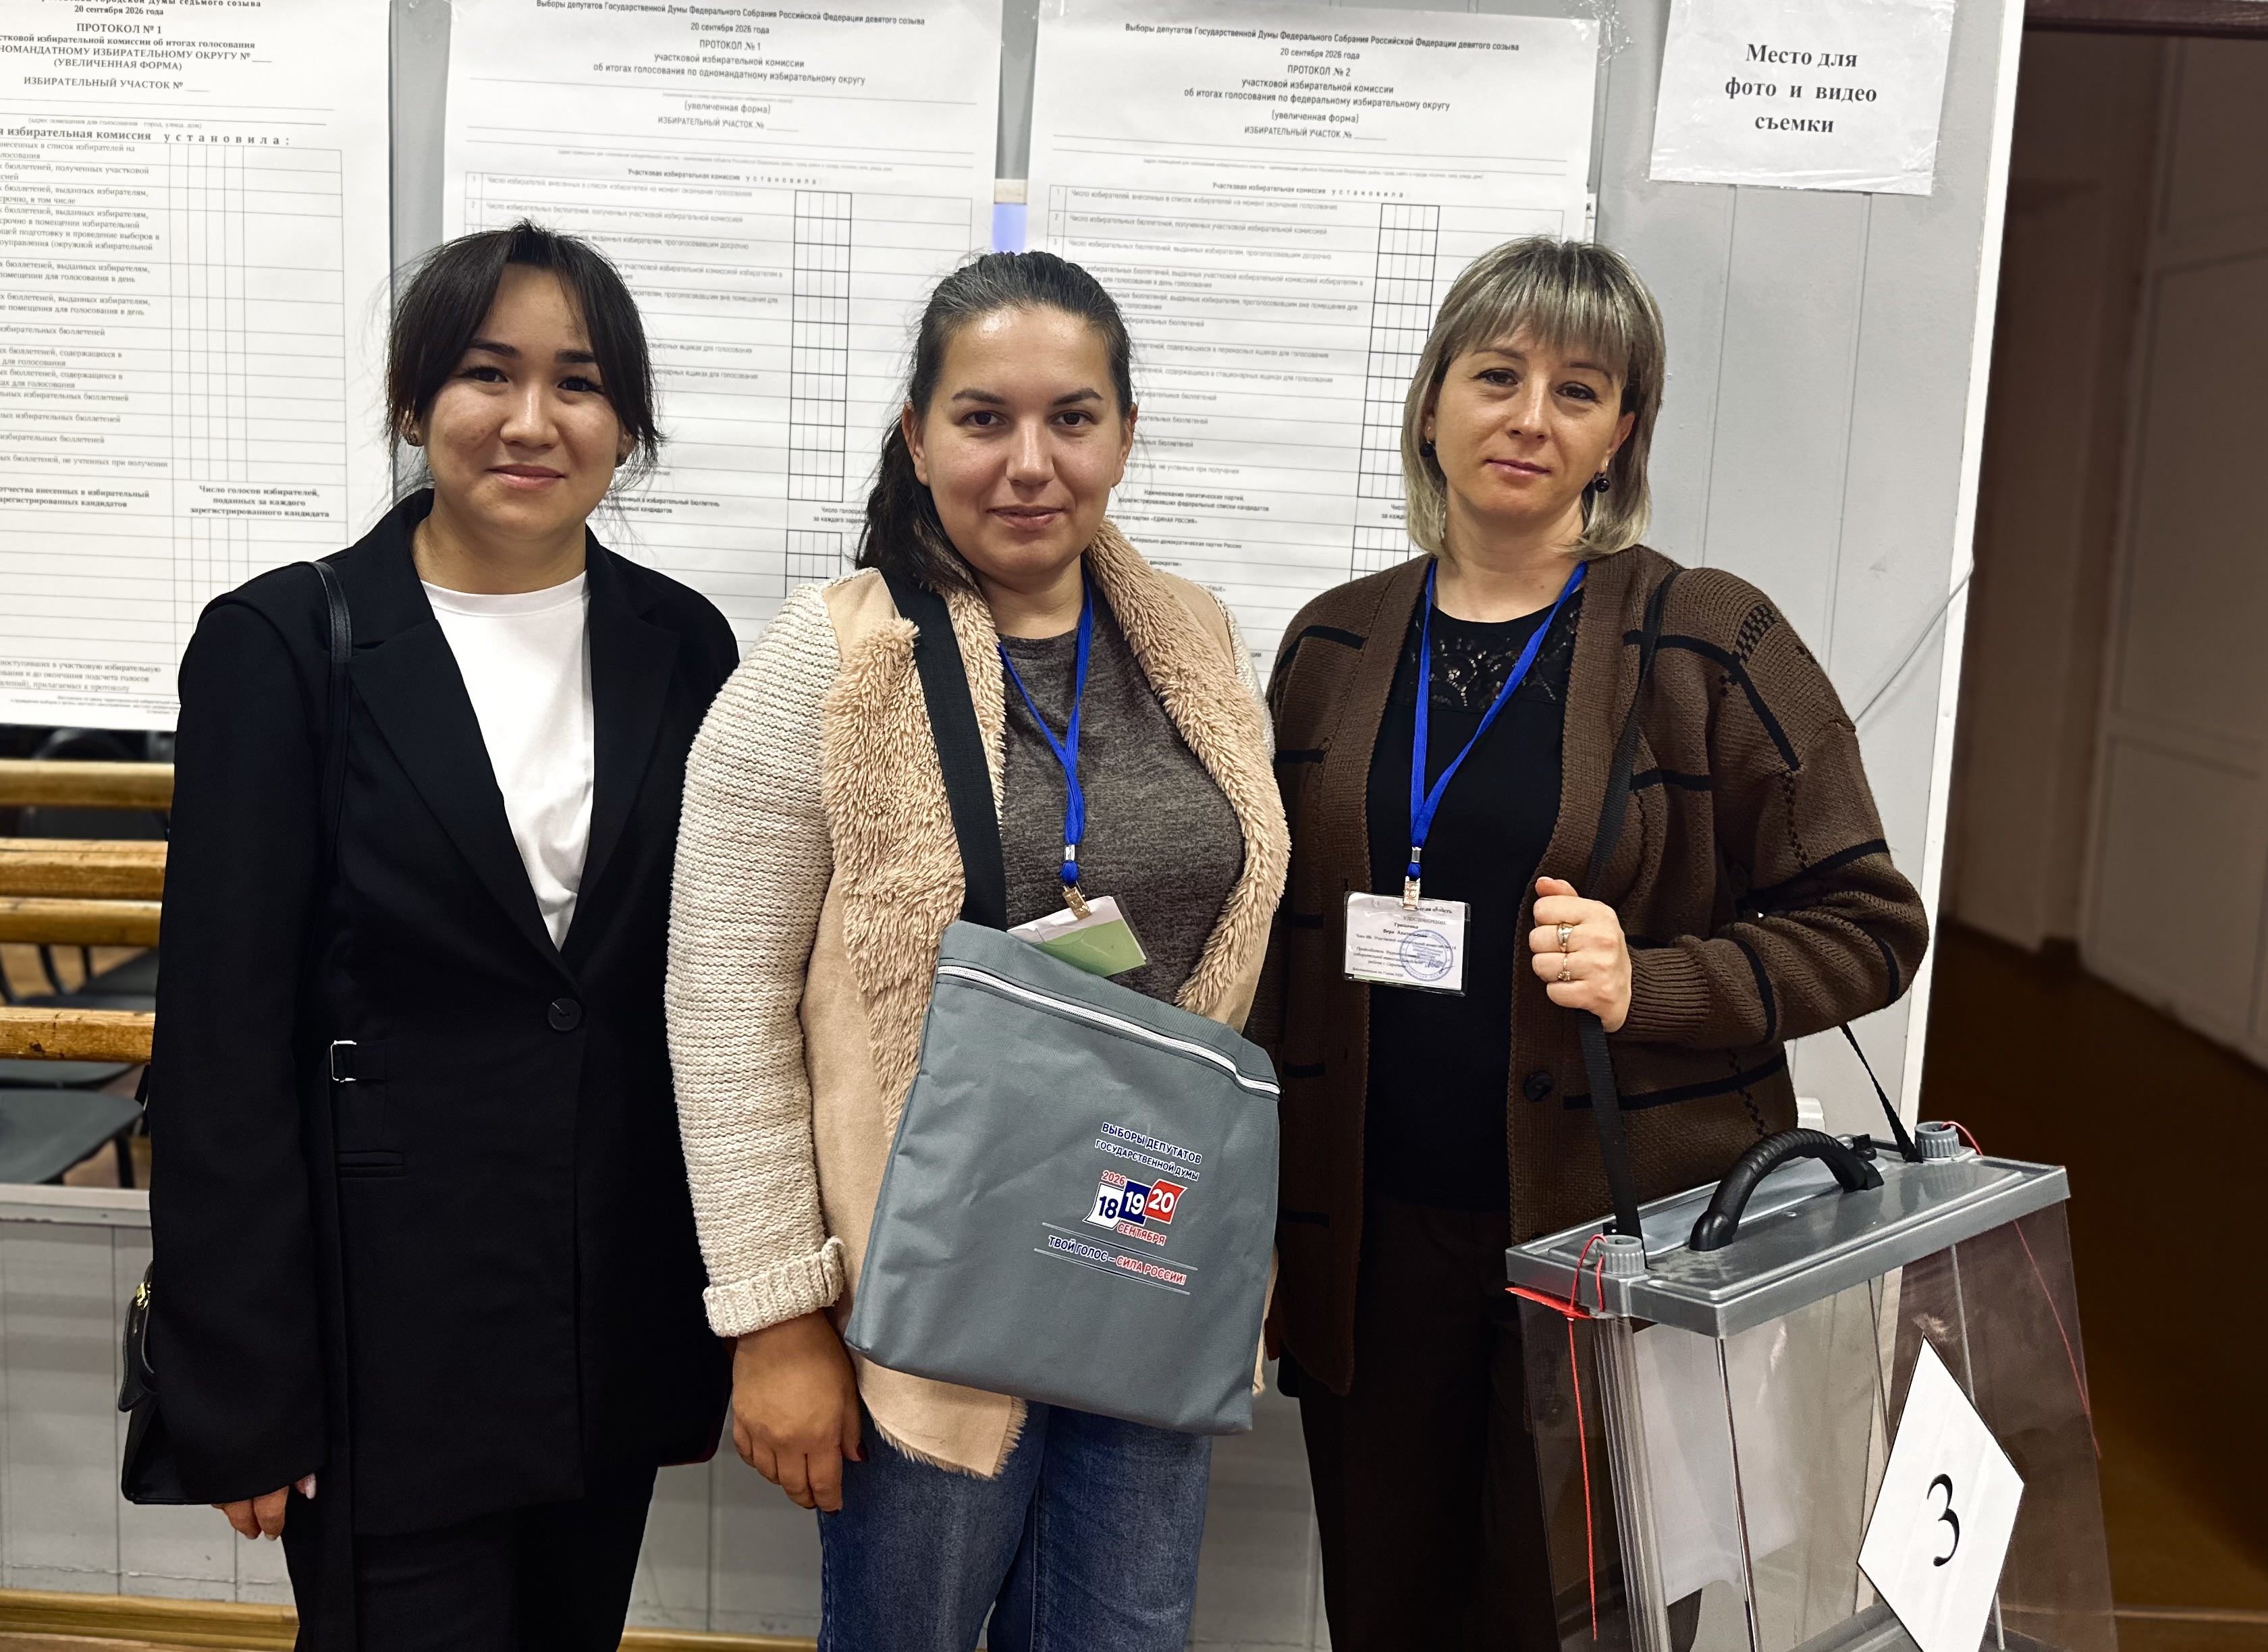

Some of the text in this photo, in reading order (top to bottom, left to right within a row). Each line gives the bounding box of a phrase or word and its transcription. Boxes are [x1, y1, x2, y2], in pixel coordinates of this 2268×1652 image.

[74, 5, 84, 13] 20
[86, 6, 124, 15] сентября
[125, 6, 144, 15] 2026
[536, 0, 566, 9] Выборы
[566, 2, 603, 10] депутатов
[604, 2, 666, 12] Государственной
[667, 5, 688, 15] Думы
[688, 5, 741, 16] Федерального
[742, 8, 778, 18] Собрания
[778, 10, 821, 20] Российской
[822, 12, 864, 22] Федерации
[865, 16, 897, 24] девятого
[76, 23, 161, 34] ПРОТОКОЛ № 1
[691, 22, 700, 30] 20
[701, 24, 734, 32] сентября
[734, 24, 752, 33] 2026
[37, 35, 105, 45] избирательной
[153, 38, 163, 46] об
[1125, 23, 1155, 33] Выборы
[1156, 26, 1193, 34] депутатов
[1194, 27, 1257, 38] Государственной
[1257, 30, 1278, 40] Думы
[1280, 31, 1332, 42] Федерального
[1334, 34, 1369, 44] Собрания
[1370, 36, 1414, 45] Российской
[1415, 38, 1457, 48] Федерации
[1492, 43, 1519, 51] созыва
[699, 39, 761, 51] ПРОТОКОЛ № 1
[93, 48, 193, 58] ИЗБИРАТЕЛЬНОМУ
[195, 51, 238, 60] ОКРУГУ
[1280, 47, 1289, 56] 20
[1291, 49, 1324, 58] сентября
[1324, 50, 1342, 59] 2026
[1746, 44, 1857, 67] Место для
[53, 58, 182, 71] (УВЕЛИЧЕННАЯ ФОРМА)
[654, 54, 805, 67] участковой избирательной комиссии
[593, 63, 865, 86] об итогах голосования по одномандатному избирательному округу
[1287, 65, 1351, 77] ПРОТОКОЛ № 2
[24, 77, 117, 87] ИЗБИРАТЕЛЬНЫЙ
[119, 80, 170, 89] УЧАСТОК
[1241, 79, 1394, 94] участковой избирательной комиссии
[1725, 77, 1877, 102] фото и видео
[1184, 88, 1451, 111] об итогах голосования по федеральному избирательному округу
[684, 101, 771, 115] (увеличенная форма)
[657, 116, 765, 130] ИЗБИРАТЕЛЬНЫЙ УЧАСТОК №
[1271, 110, 1359, 123] (увеличенная форма)
[1754, 117, 1833, 132] съемки
[7, 127, 92, 138] избирательная
[96, 132, 151, 140] комиссия
[1244, 126, 1353, 139] ИЗБИРАТЕЛЬНЫЙ УЧАСТОК №
[198, 485, 225, 493] Число
[263, 489, 320, 497] избирателей,
[1102, 1122, 1202, 1164] ВЫБОРЫ ДЕПУТАТОВ
[1095, 1139, 1199, 1181] ГОСУДАРСТВЕННОЙ ДУМЫ
[1101, 1170, 1127, 1186] 2026
[1099, 1188, 1174, 1219] 18 19 20
[1116, 1221, 1166, 1246] СЕНТЯБРЯ
[1048, 1235, 1075, 1252] ТВОЙ
[1075, 1244, 1108, 1263] ГОЛОС
[1116, 1255, 1143, 1273] СИЛА
[1143, 1263, 1187, 1286] РОССИИ!
[1927, 1473, 1960, 1567] 3
